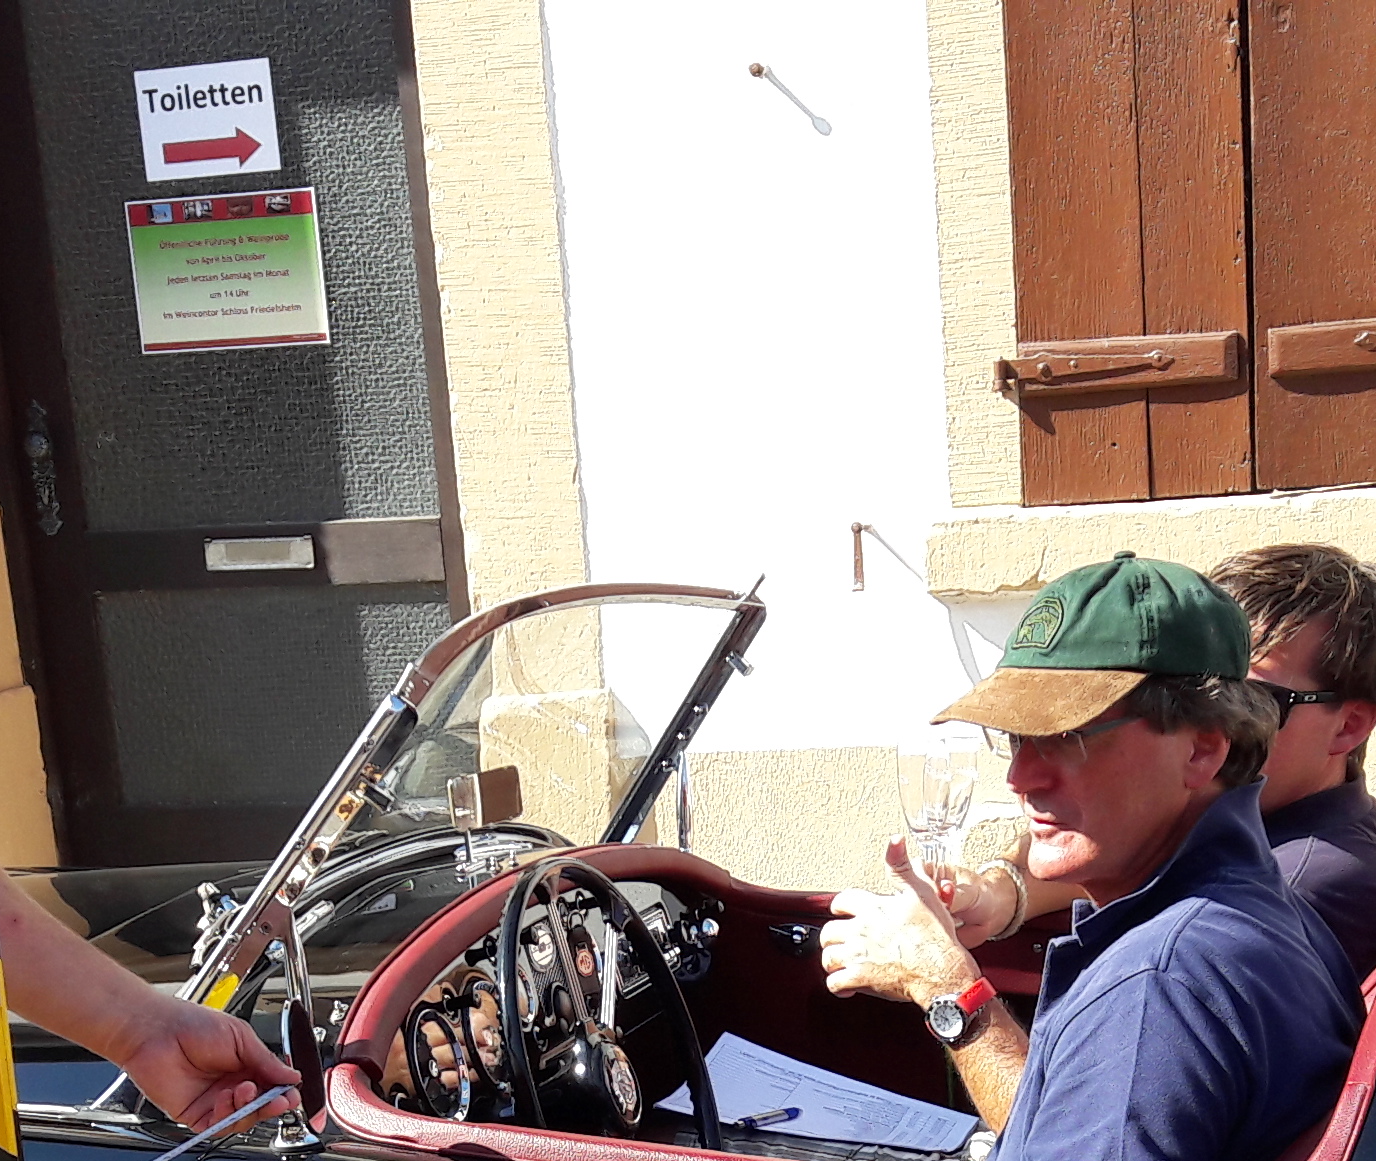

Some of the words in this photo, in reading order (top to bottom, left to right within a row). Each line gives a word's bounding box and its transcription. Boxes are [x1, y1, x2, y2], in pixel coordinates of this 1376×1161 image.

[142, 83, 263, 113] Toiletten
[224, 290, 234, 298] 14
[235, 289, 249, 297] Uhr
